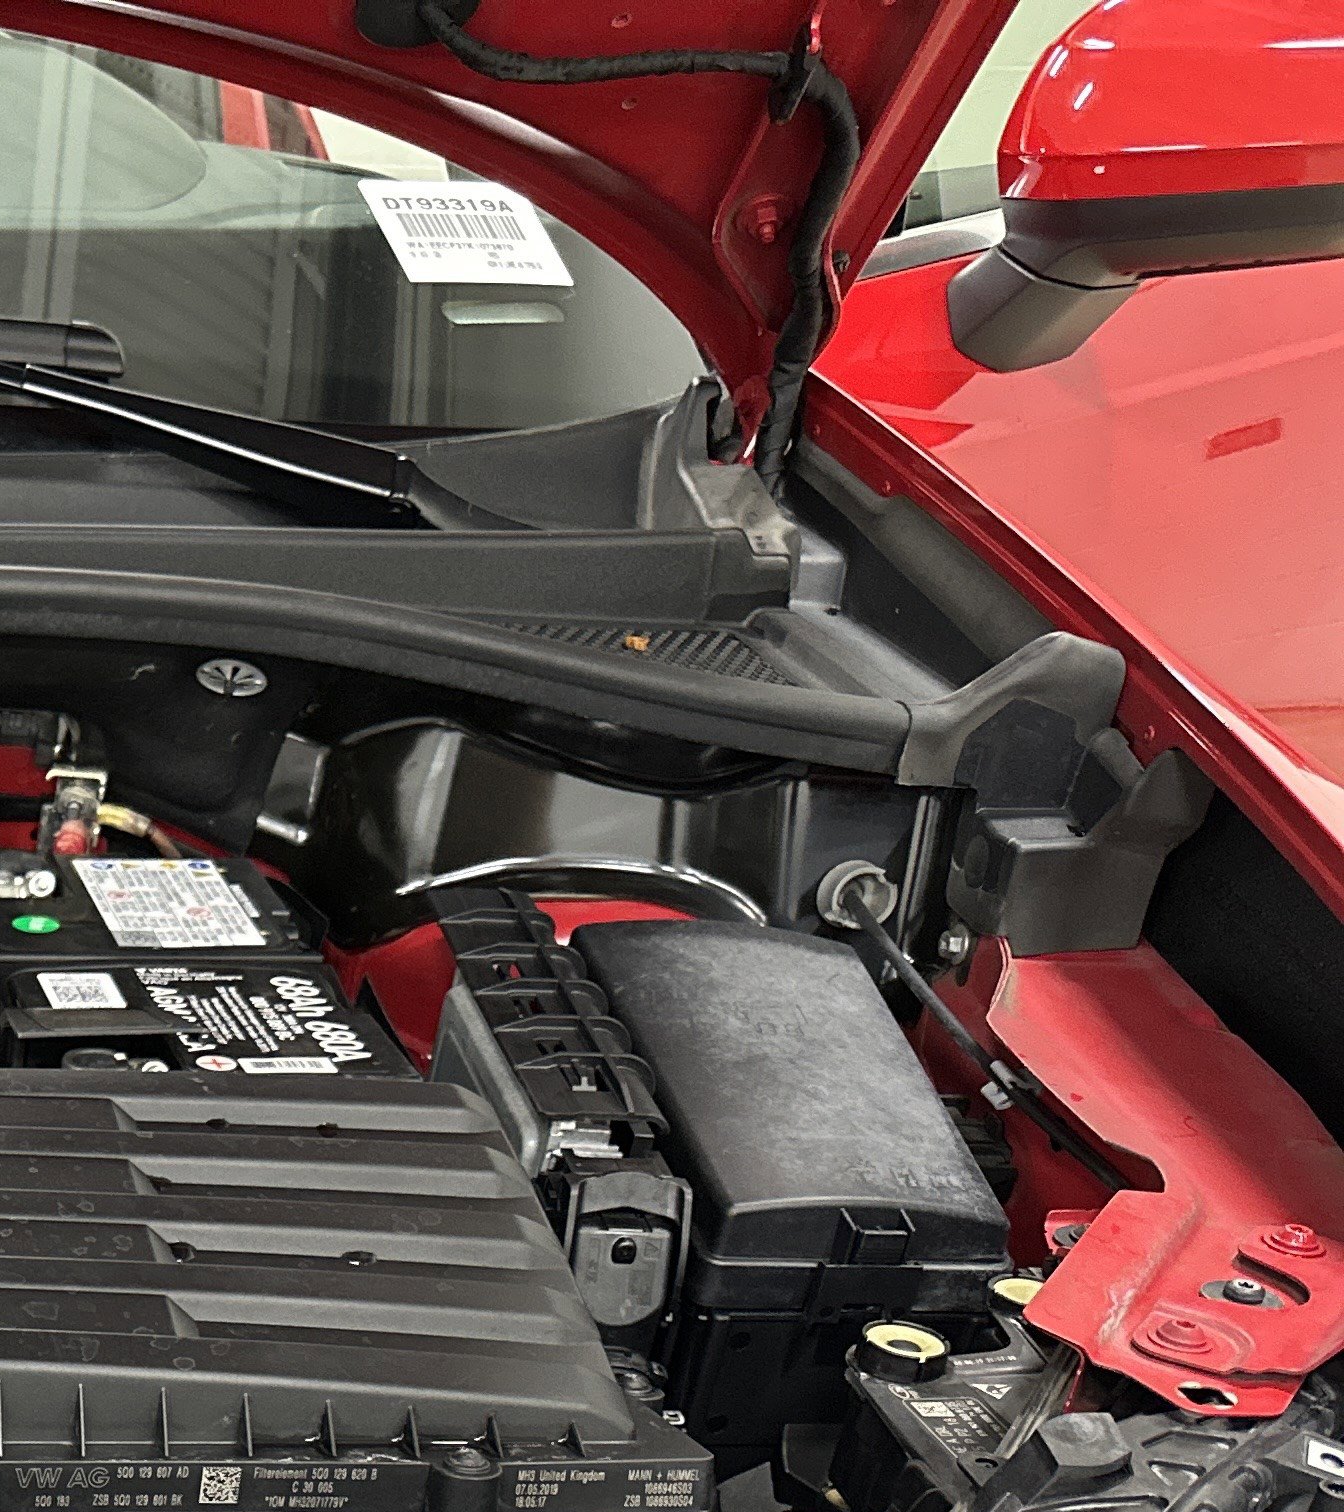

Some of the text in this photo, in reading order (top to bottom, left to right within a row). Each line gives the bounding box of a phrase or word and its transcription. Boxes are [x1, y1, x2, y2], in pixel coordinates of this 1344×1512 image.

[382, 197, 514, 213] DT93319A
[270, 975, 334, 1018] 68Ah
[304, 1020, 372, 1063] 680A
[666, 1468, 699, 1481] HUMMEL
